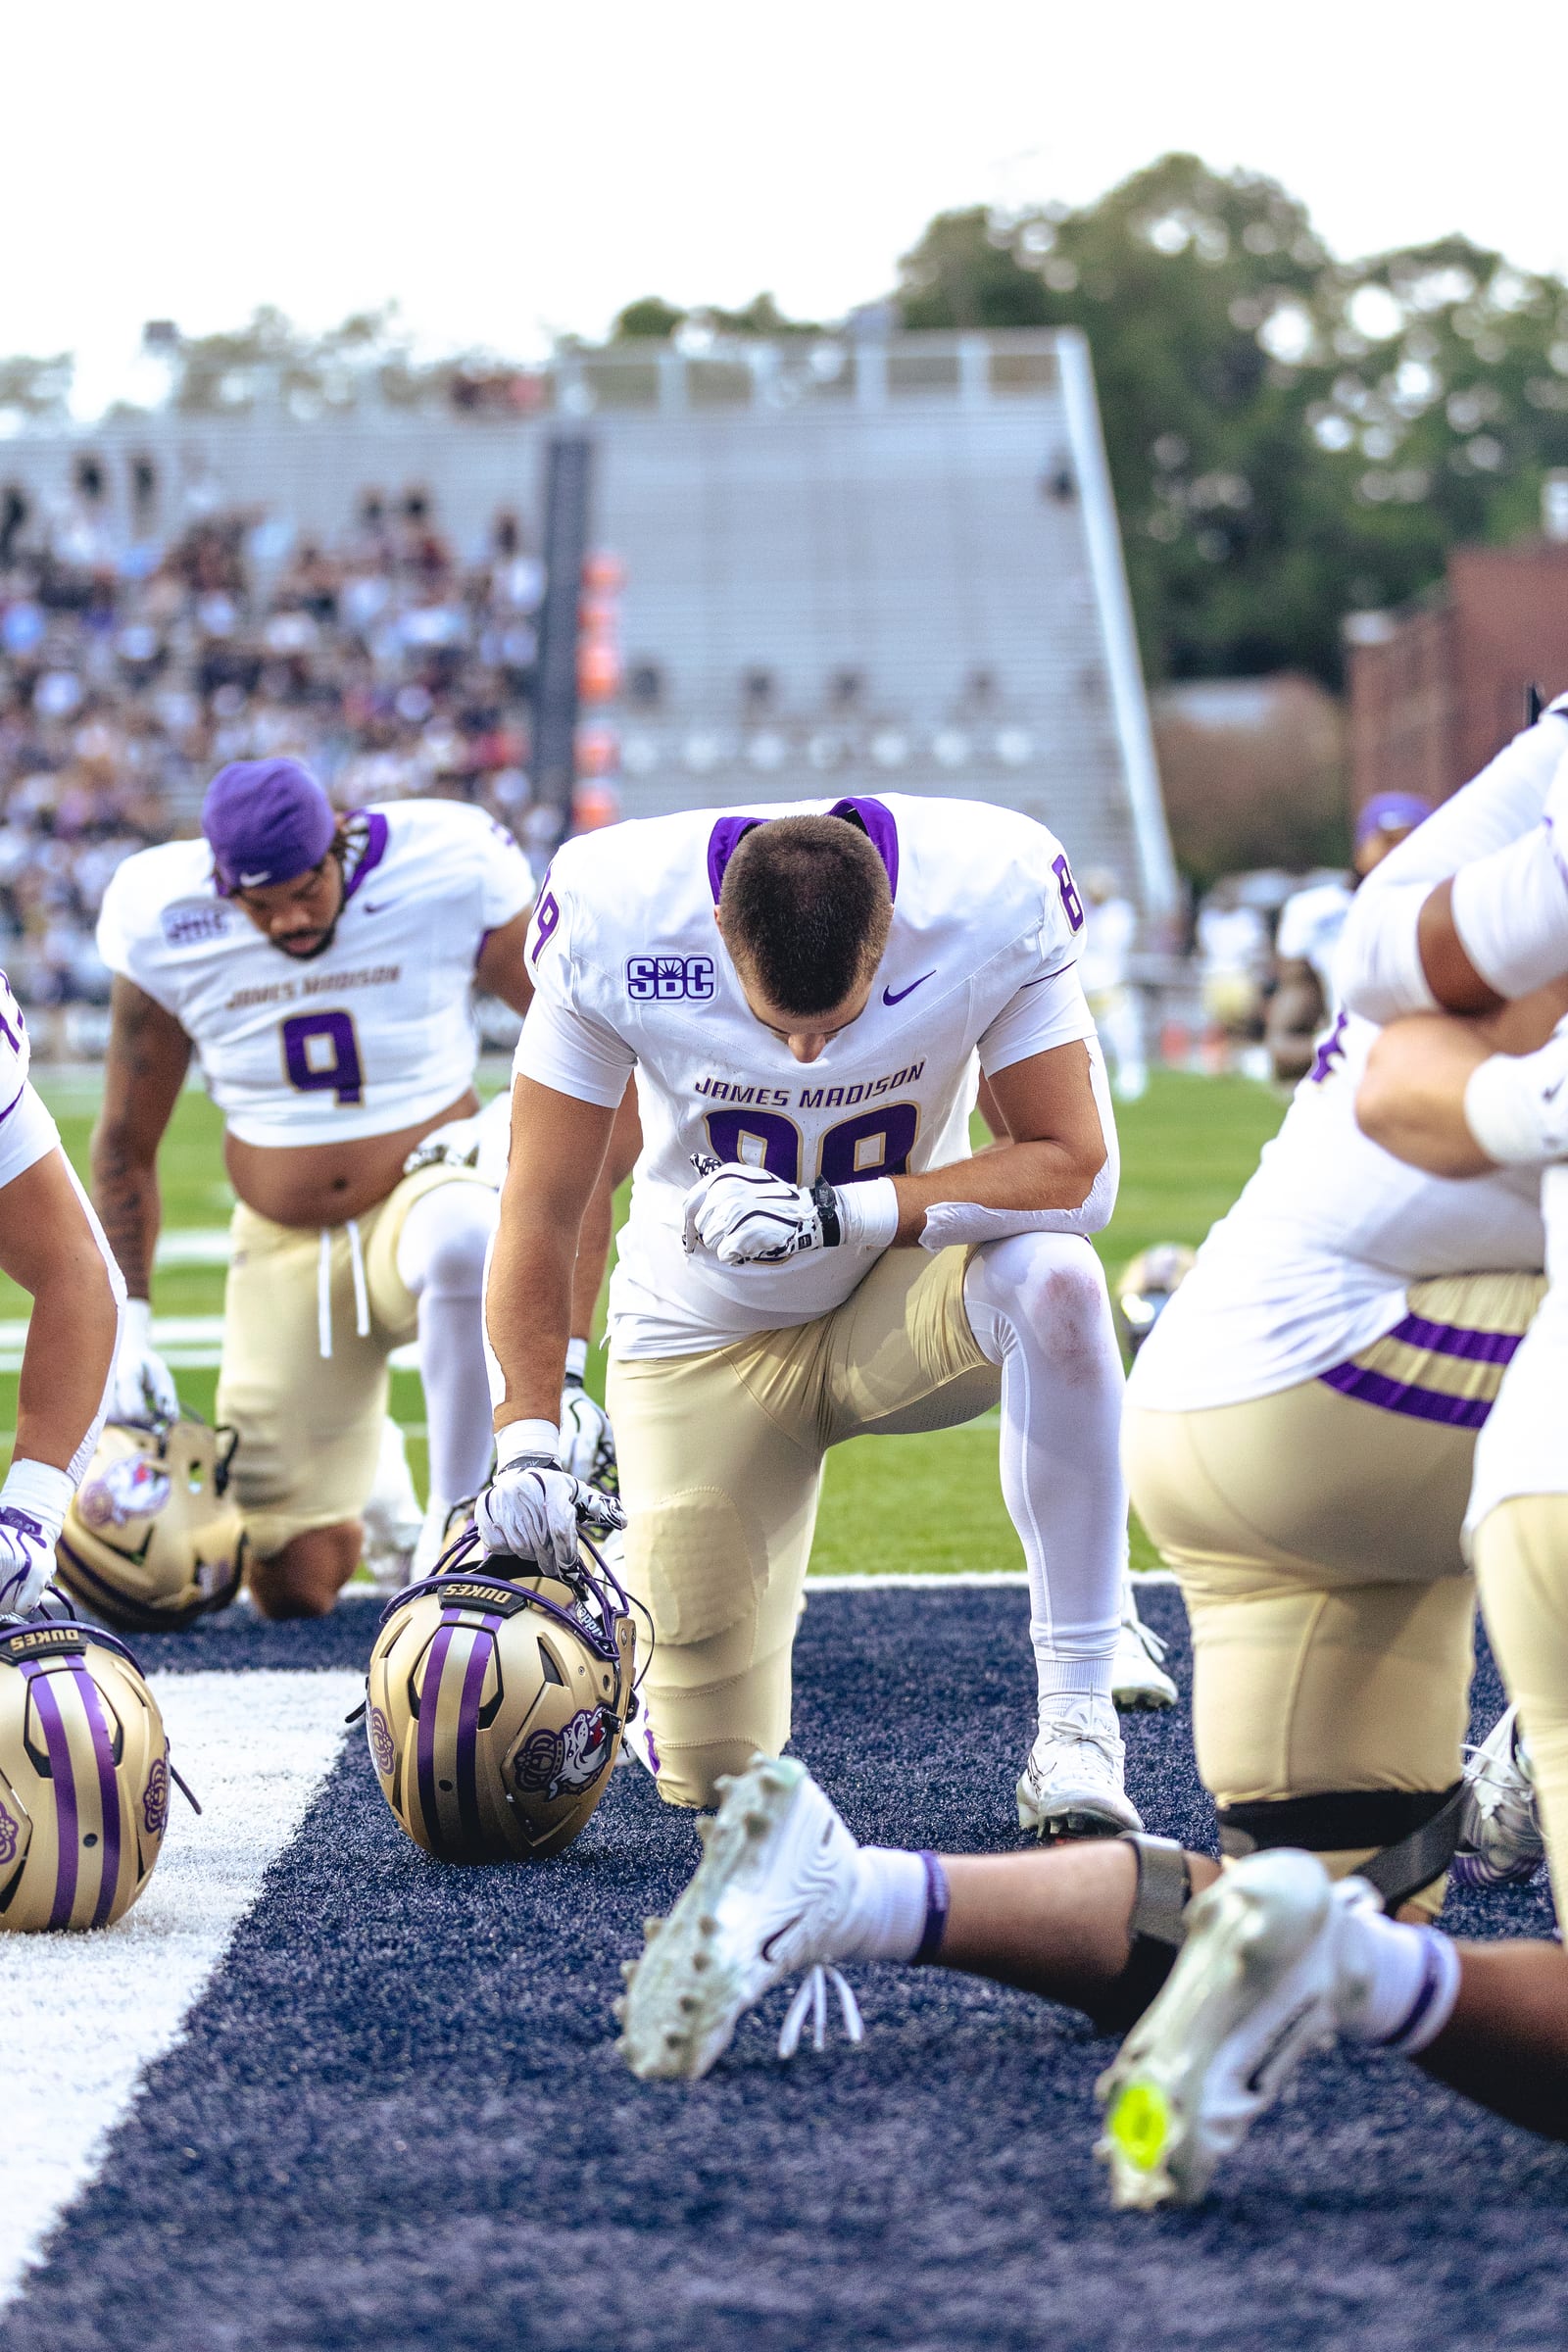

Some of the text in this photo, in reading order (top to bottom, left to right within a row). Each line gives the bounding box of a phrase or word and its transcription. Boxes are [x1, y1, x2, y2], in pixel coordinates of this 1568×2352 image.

[626, 956, 715, 1001] SBC
[278, 1007, 367, 1108] 9
[694, 1060, 927, 1108] JAMES MADISON
[442, 1583, 513, 1604] DUKES
[9, 1628, 79, 1652] DUKES
